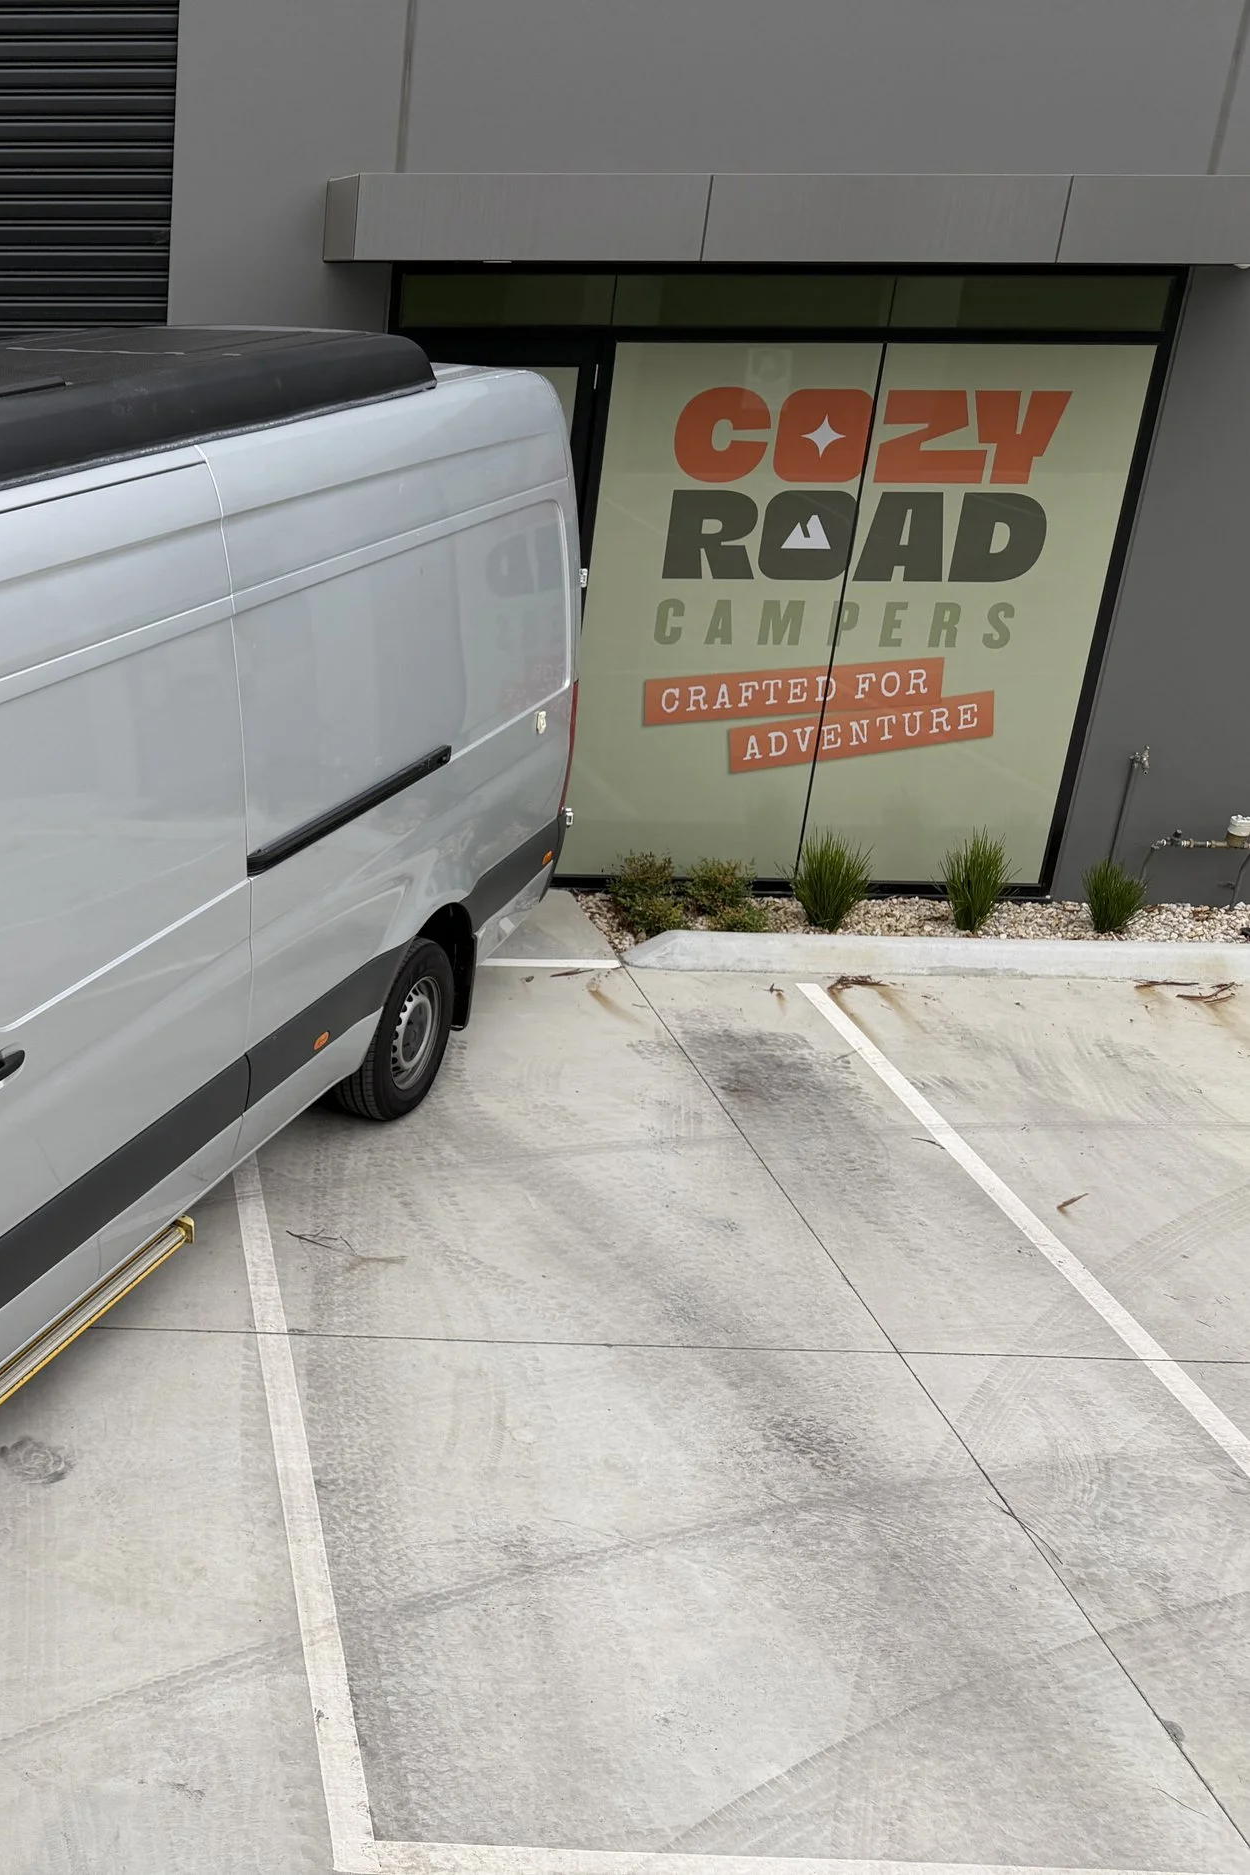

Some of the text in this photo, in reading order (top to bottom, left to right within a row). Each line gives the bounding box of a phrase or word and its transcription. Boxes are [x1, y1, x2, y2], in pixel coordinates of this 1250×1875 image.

[674, 386, 1073, 485] COZY
[661, 489, 1048, 583] ROAD
[652, 598, 1016, 650] CAMPERS
[660, 668, 929, 714] CRAFTED FOR
[742, 704, 979, 761] ADVENTURE
